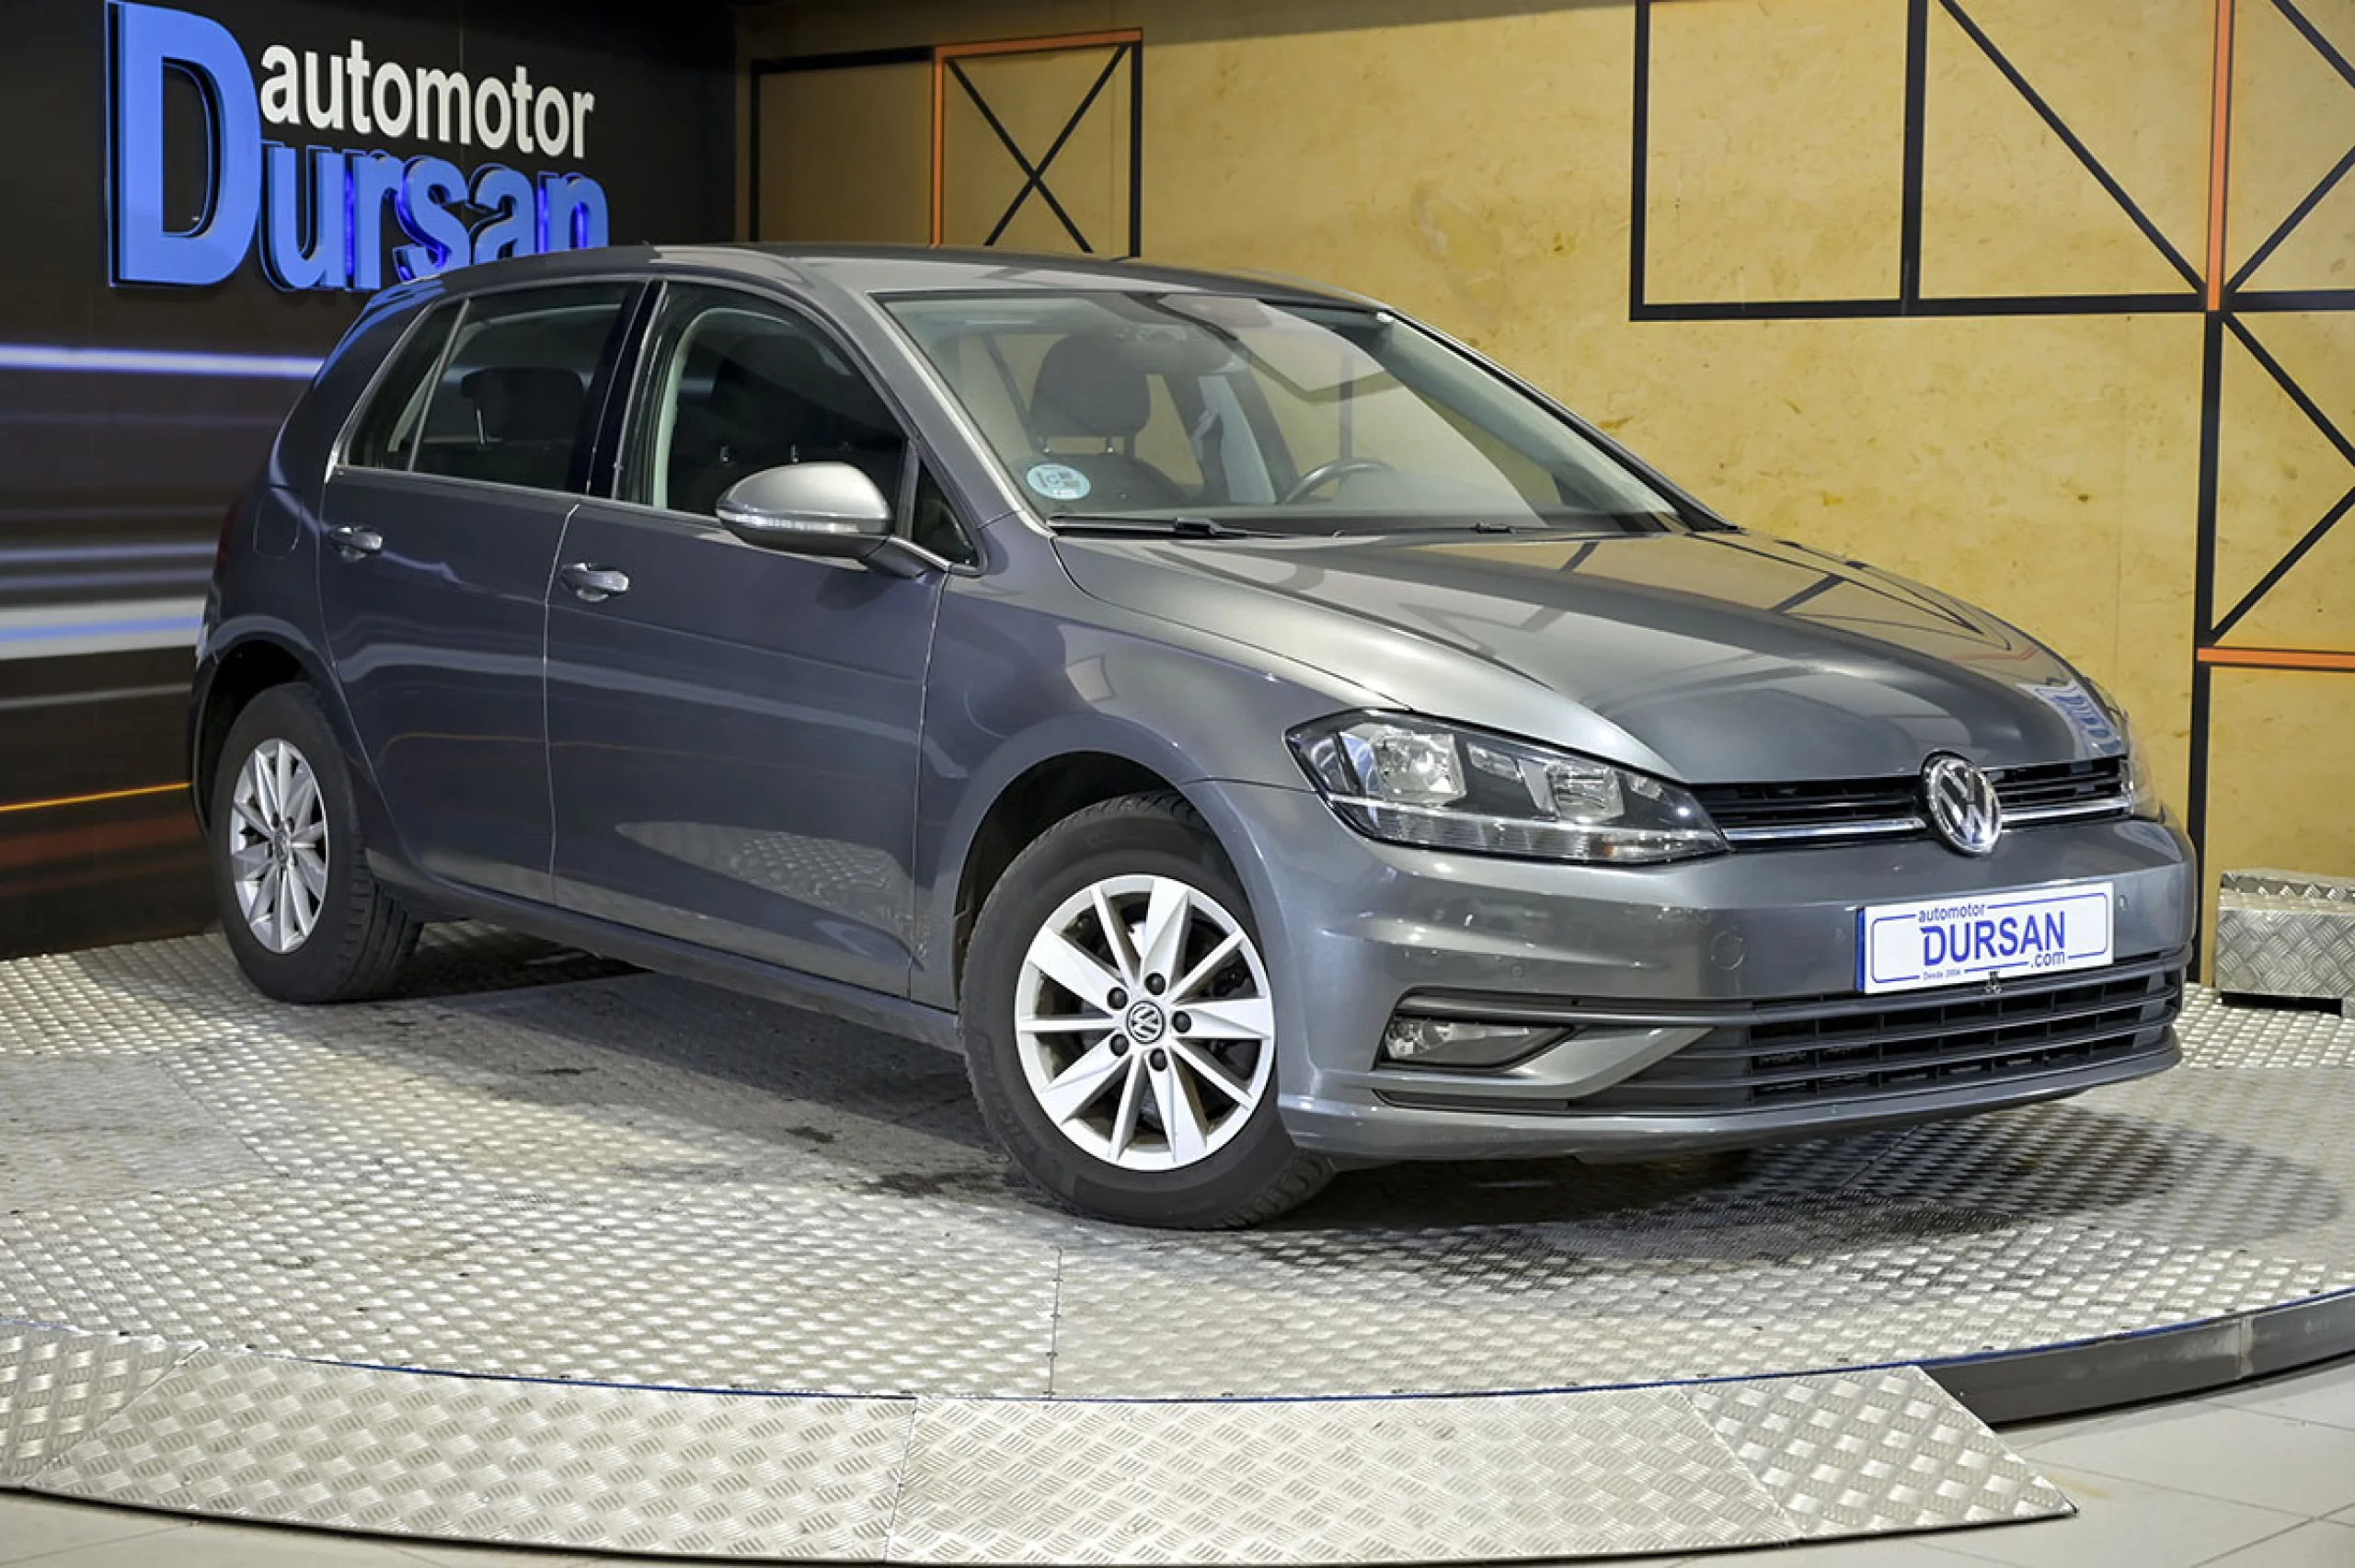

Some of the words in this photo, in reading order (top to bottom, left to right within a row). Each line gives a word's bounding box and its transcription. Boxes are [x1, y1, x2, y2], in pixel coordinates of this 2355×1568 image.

[260, 40, 594, 158] automotor
[106, 0, 609, 291] Dursan
[1918, 903, 1985, 923] automotor
[1920, 910, 2065, 966] DURSAN
[2030, 951, 2065, 968] .com
